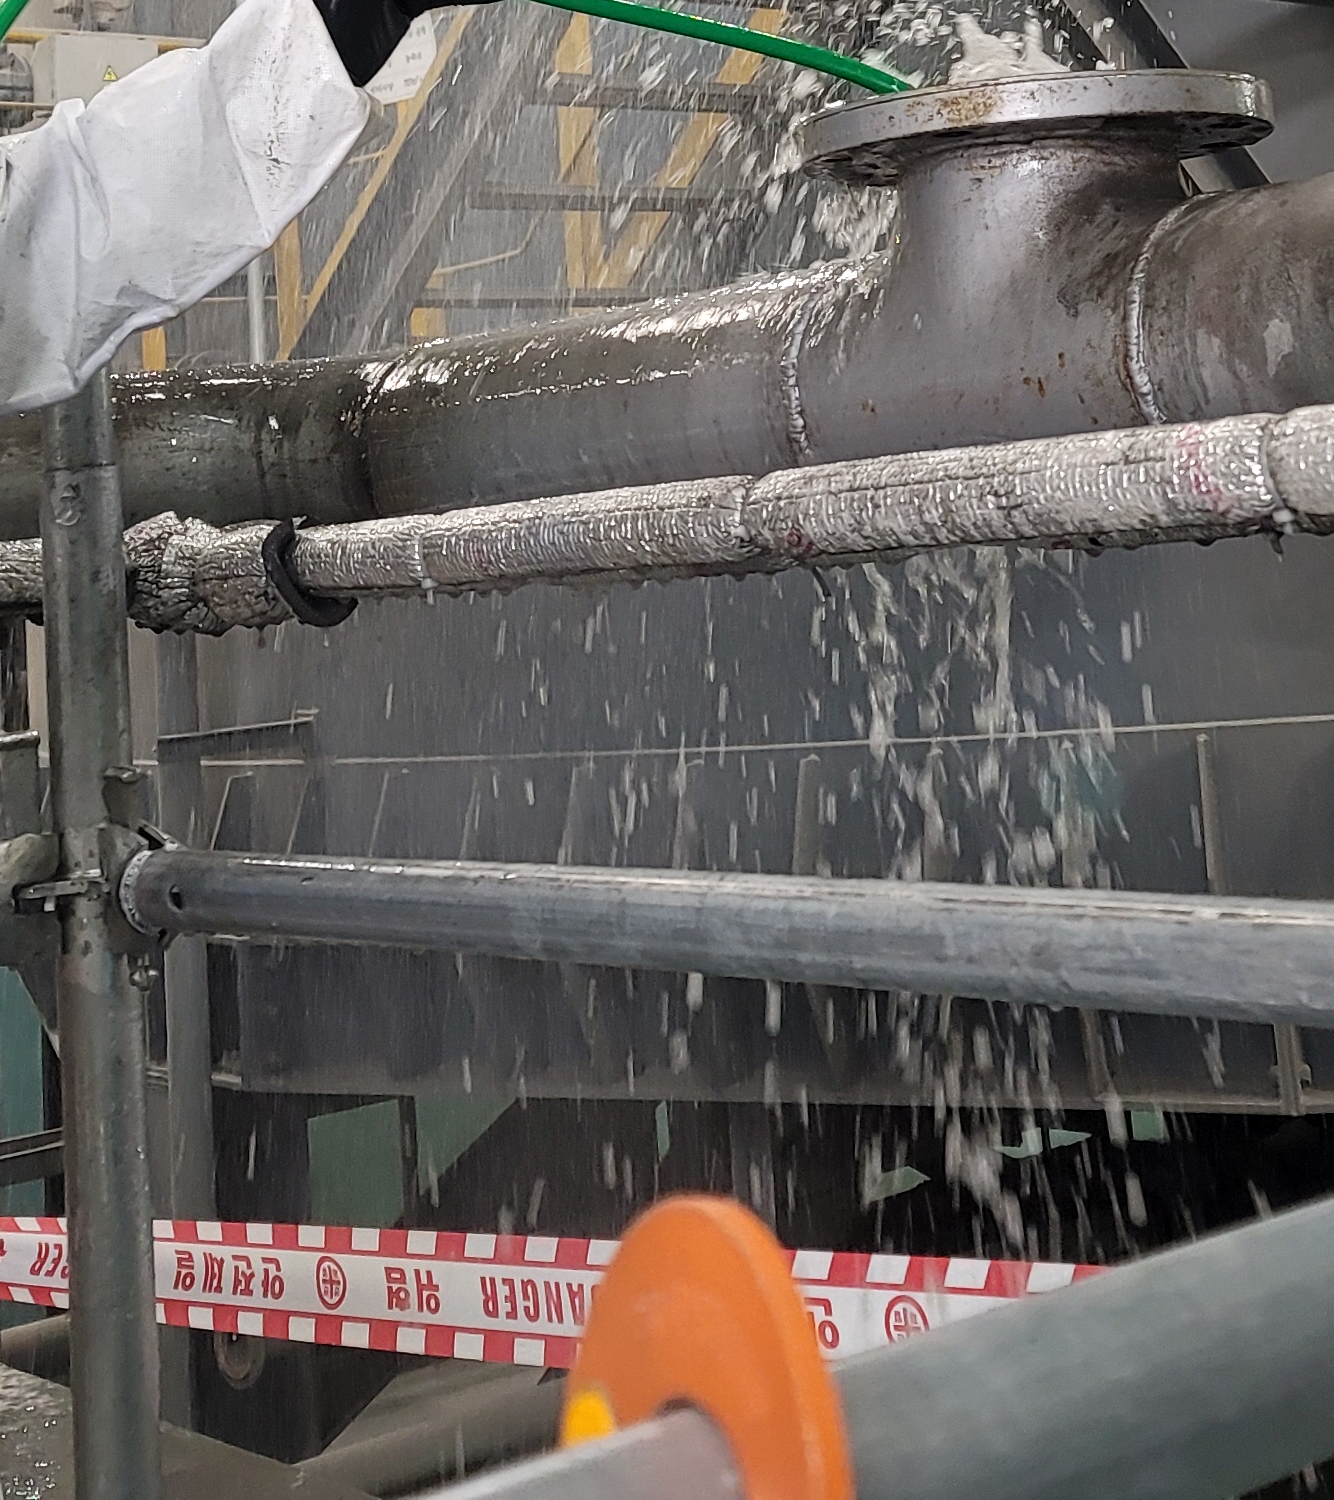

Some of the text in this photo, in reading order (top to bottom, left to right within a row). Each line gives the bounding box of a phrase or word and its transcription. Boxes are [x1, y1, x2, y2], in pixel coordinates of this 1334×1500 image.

[172, 1249, 285, 1300] 안전제일
[383, 1266, 441, 1315] 위험
[479, 1275, 597, 1327] ANGER
